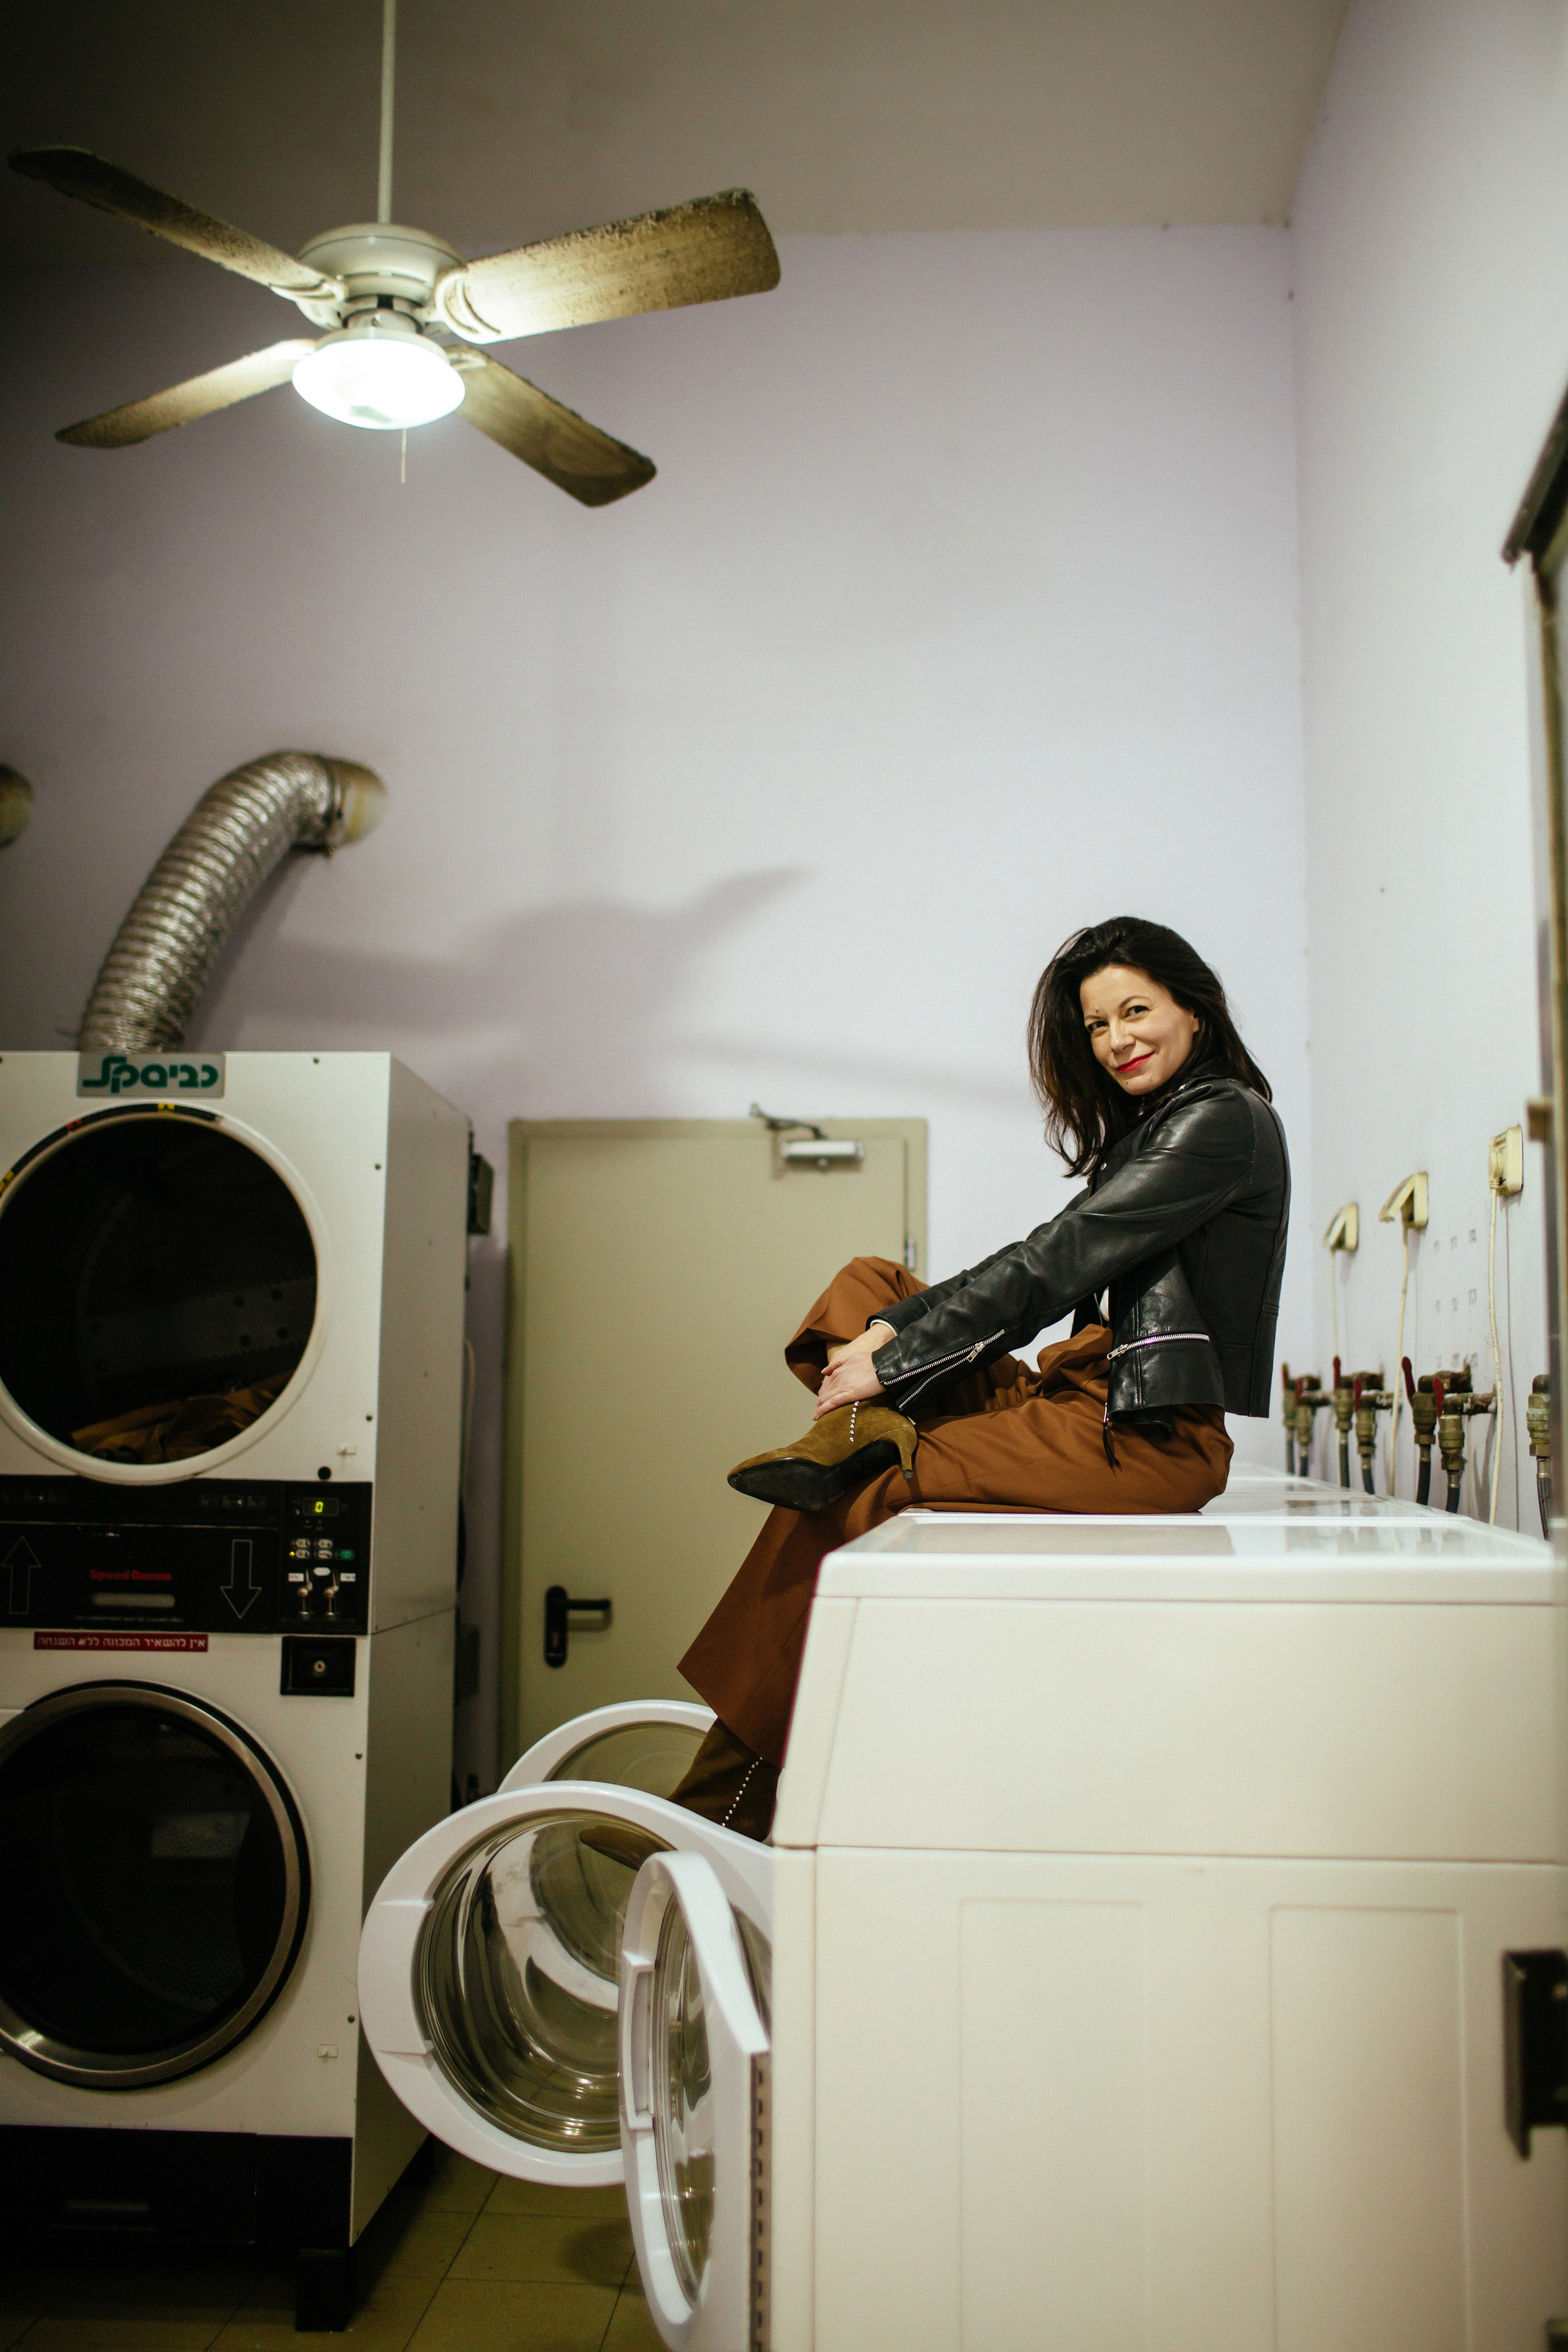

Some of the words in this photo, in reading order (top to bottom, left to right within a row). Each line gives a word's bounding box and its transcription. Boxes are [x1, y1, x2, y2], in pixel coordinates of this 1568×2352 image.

[83, 1056, 219, 1093] כביסקל
[314, 1501, 324, 1513] 0
[89, 1569, 130, 1582] Speed
[130, 1569, 172, 1581] Queen
[144, 1637, 186, 1648] להשאיר
[189, 1638, 206, 1649] אין
